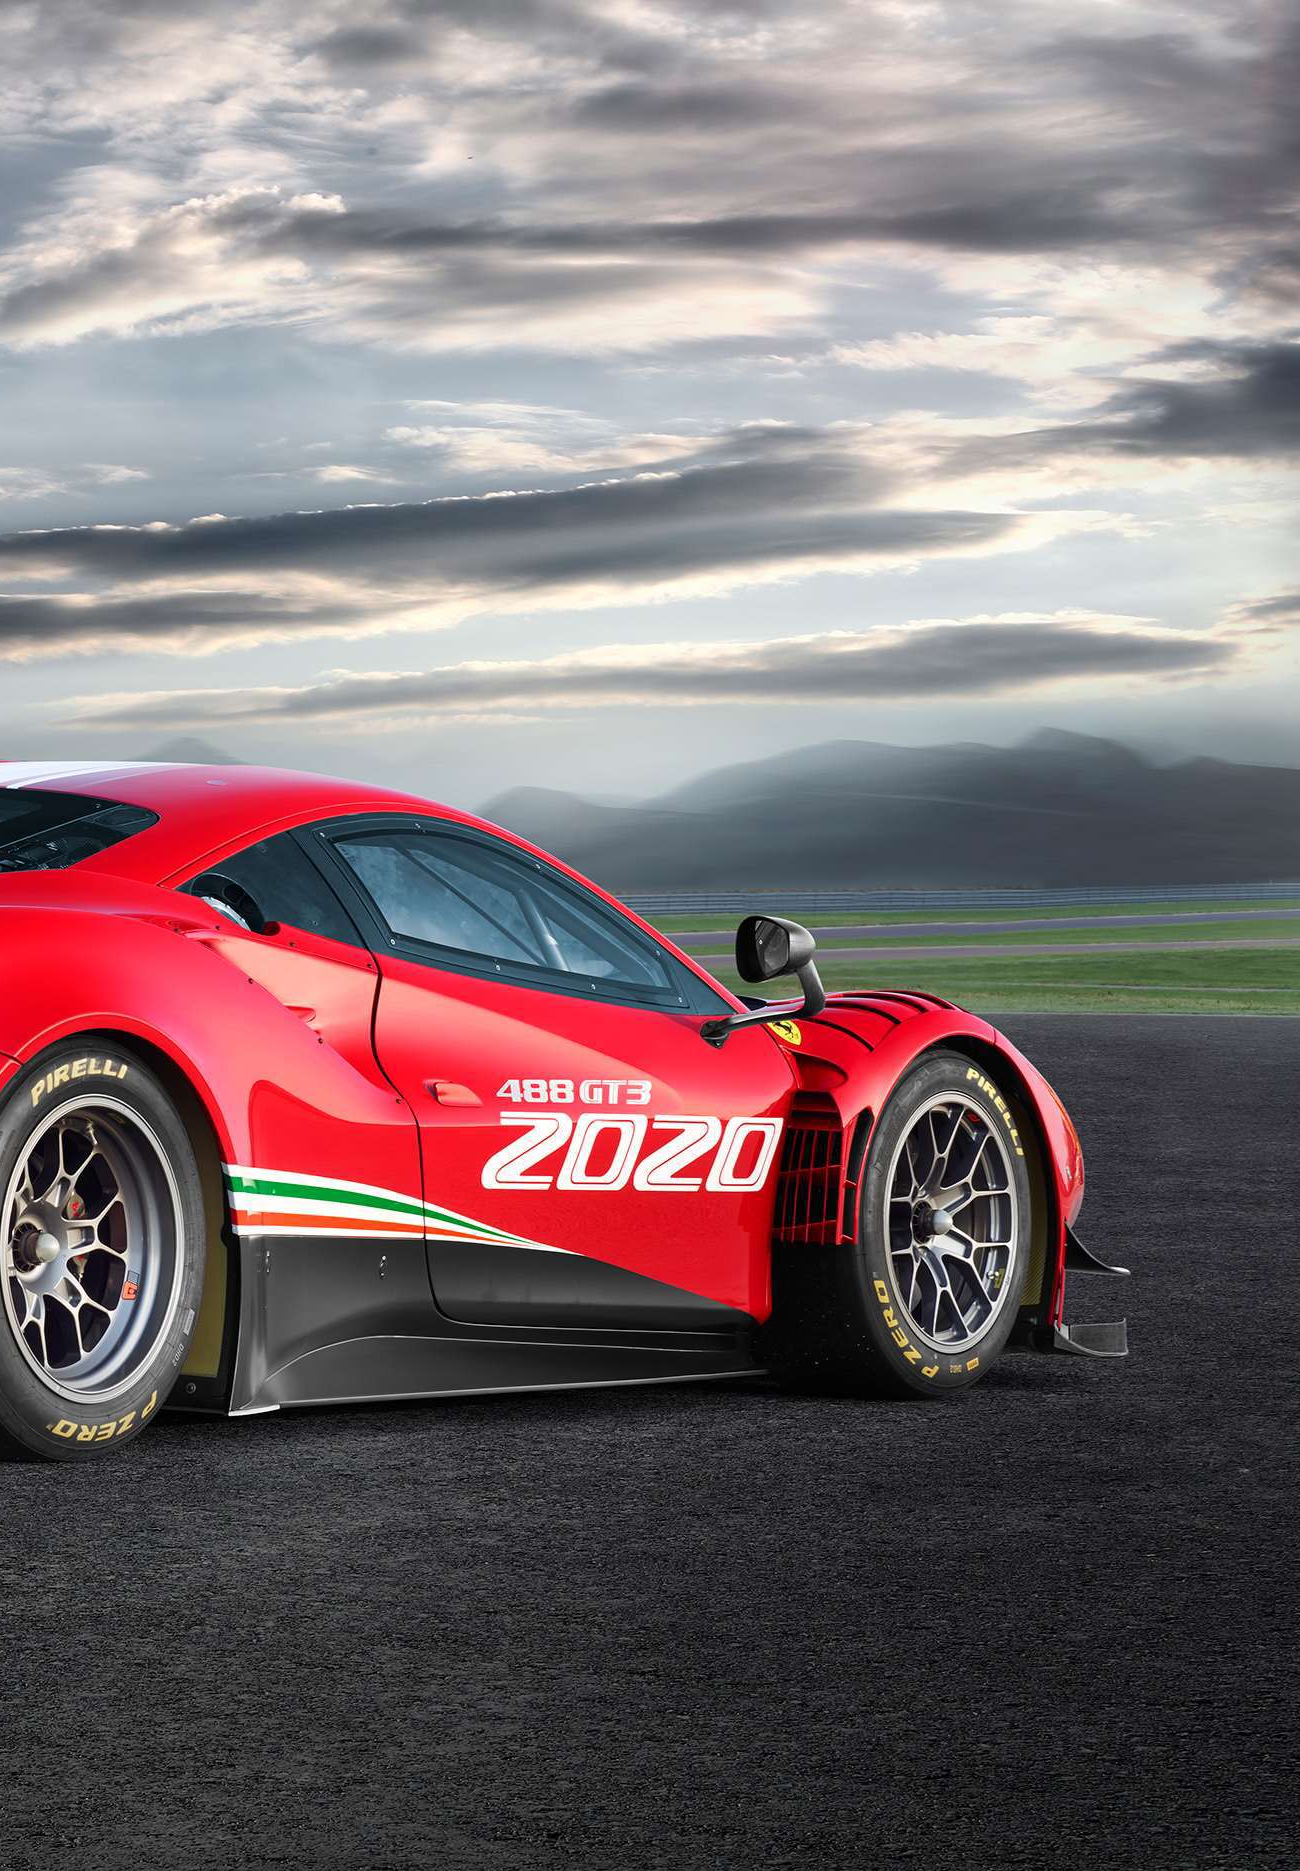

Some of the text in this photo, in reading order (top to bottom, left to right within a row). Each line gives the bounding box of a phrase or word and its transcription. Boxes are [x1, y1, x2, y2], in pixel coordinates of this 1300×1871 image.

[30, 1058, 128, 1108] PIRELLI
[496, 1079, 652, 1105] 488 GT3
[966, 1067, 1024, 1156] PIRELLI
[481, 1111, 784, 1192] 2020
[873, 1280, 939, 1378] P ZERO
[51, 1390, 157, 1442] P ZERO
